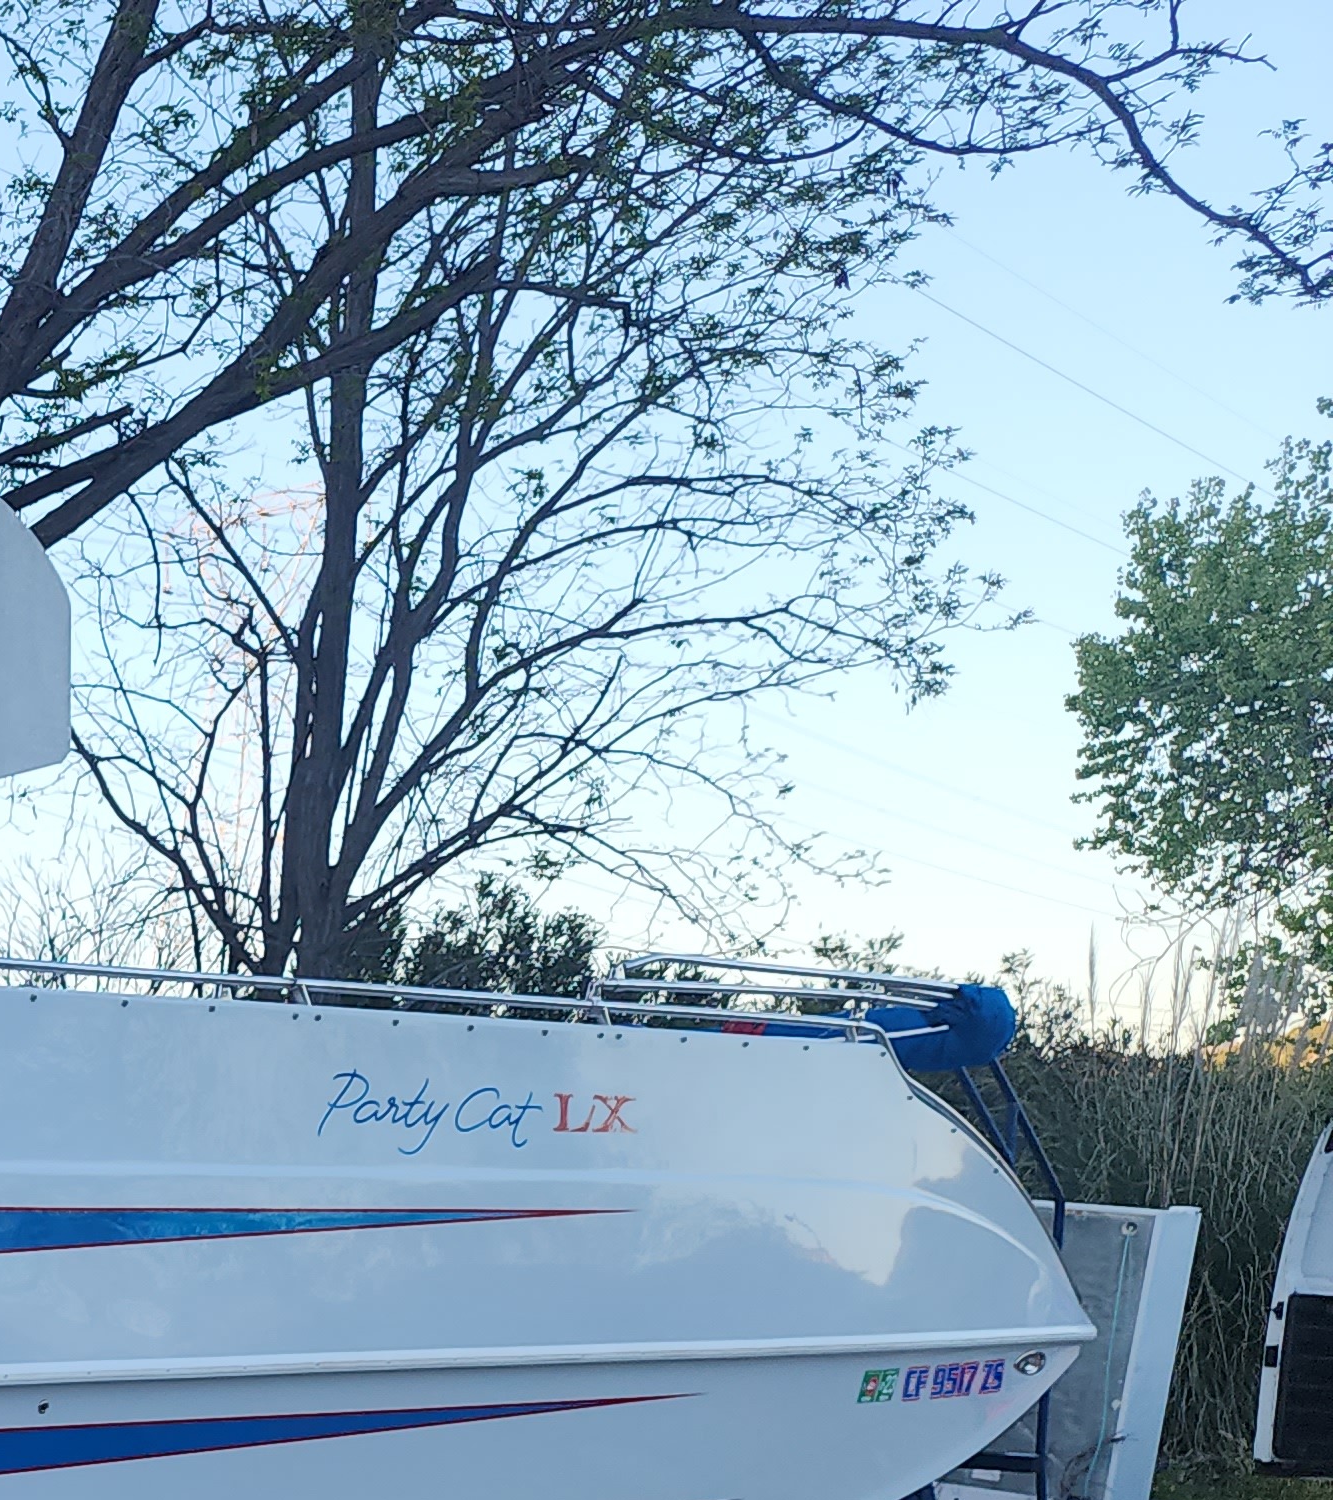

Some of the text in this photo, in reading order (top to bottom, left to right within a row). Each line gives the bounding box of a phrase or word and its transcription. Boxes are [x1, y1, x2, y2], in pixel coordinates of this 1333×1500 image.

[317, 1068, 639, 1155] Party Cat LX
[901, 1365, 931, 1402] CF
